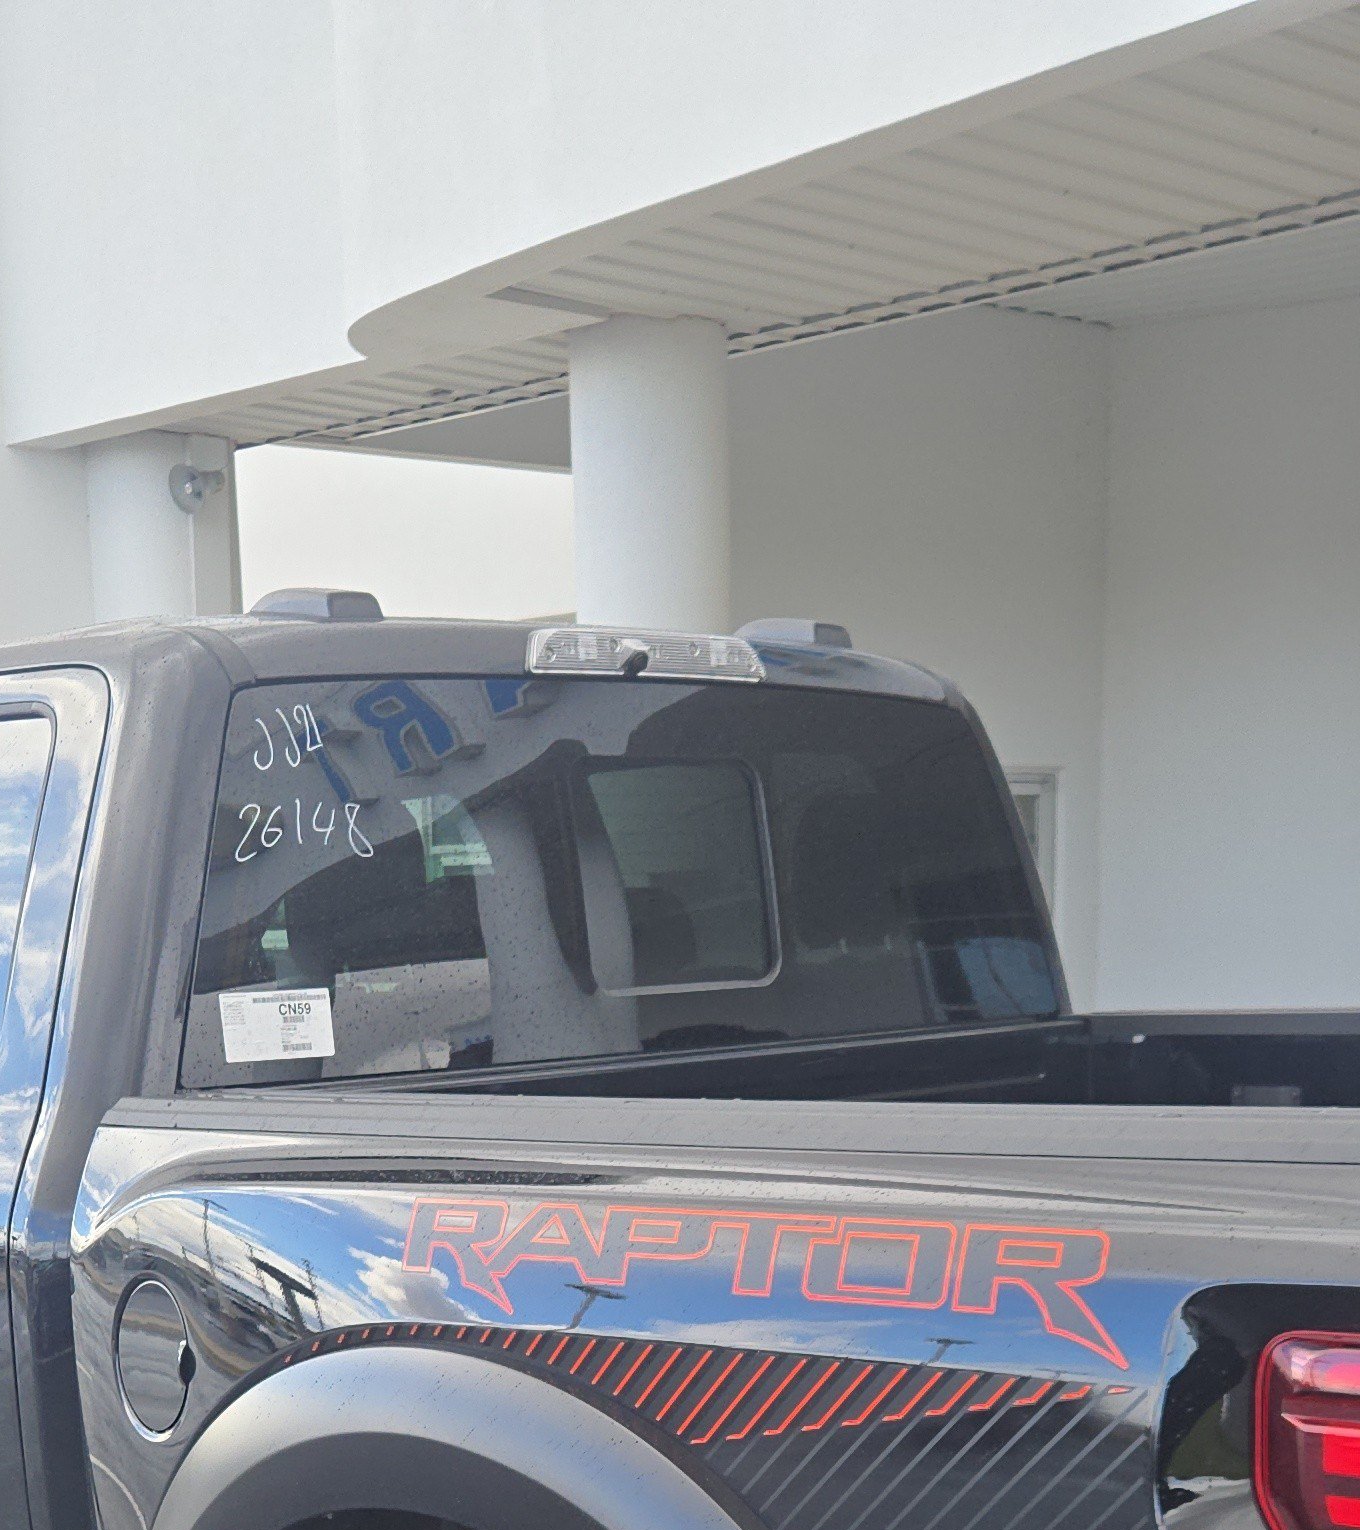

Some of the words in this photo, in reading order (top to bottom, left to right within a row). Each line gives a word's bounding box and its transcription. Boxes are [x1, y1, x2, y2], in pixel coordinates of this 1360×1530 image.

[234, 798, 374, 862] 26148
[278, 1002, 311, 1016] CN59
[401, 1199, 1130, 1370] RAPTOR
